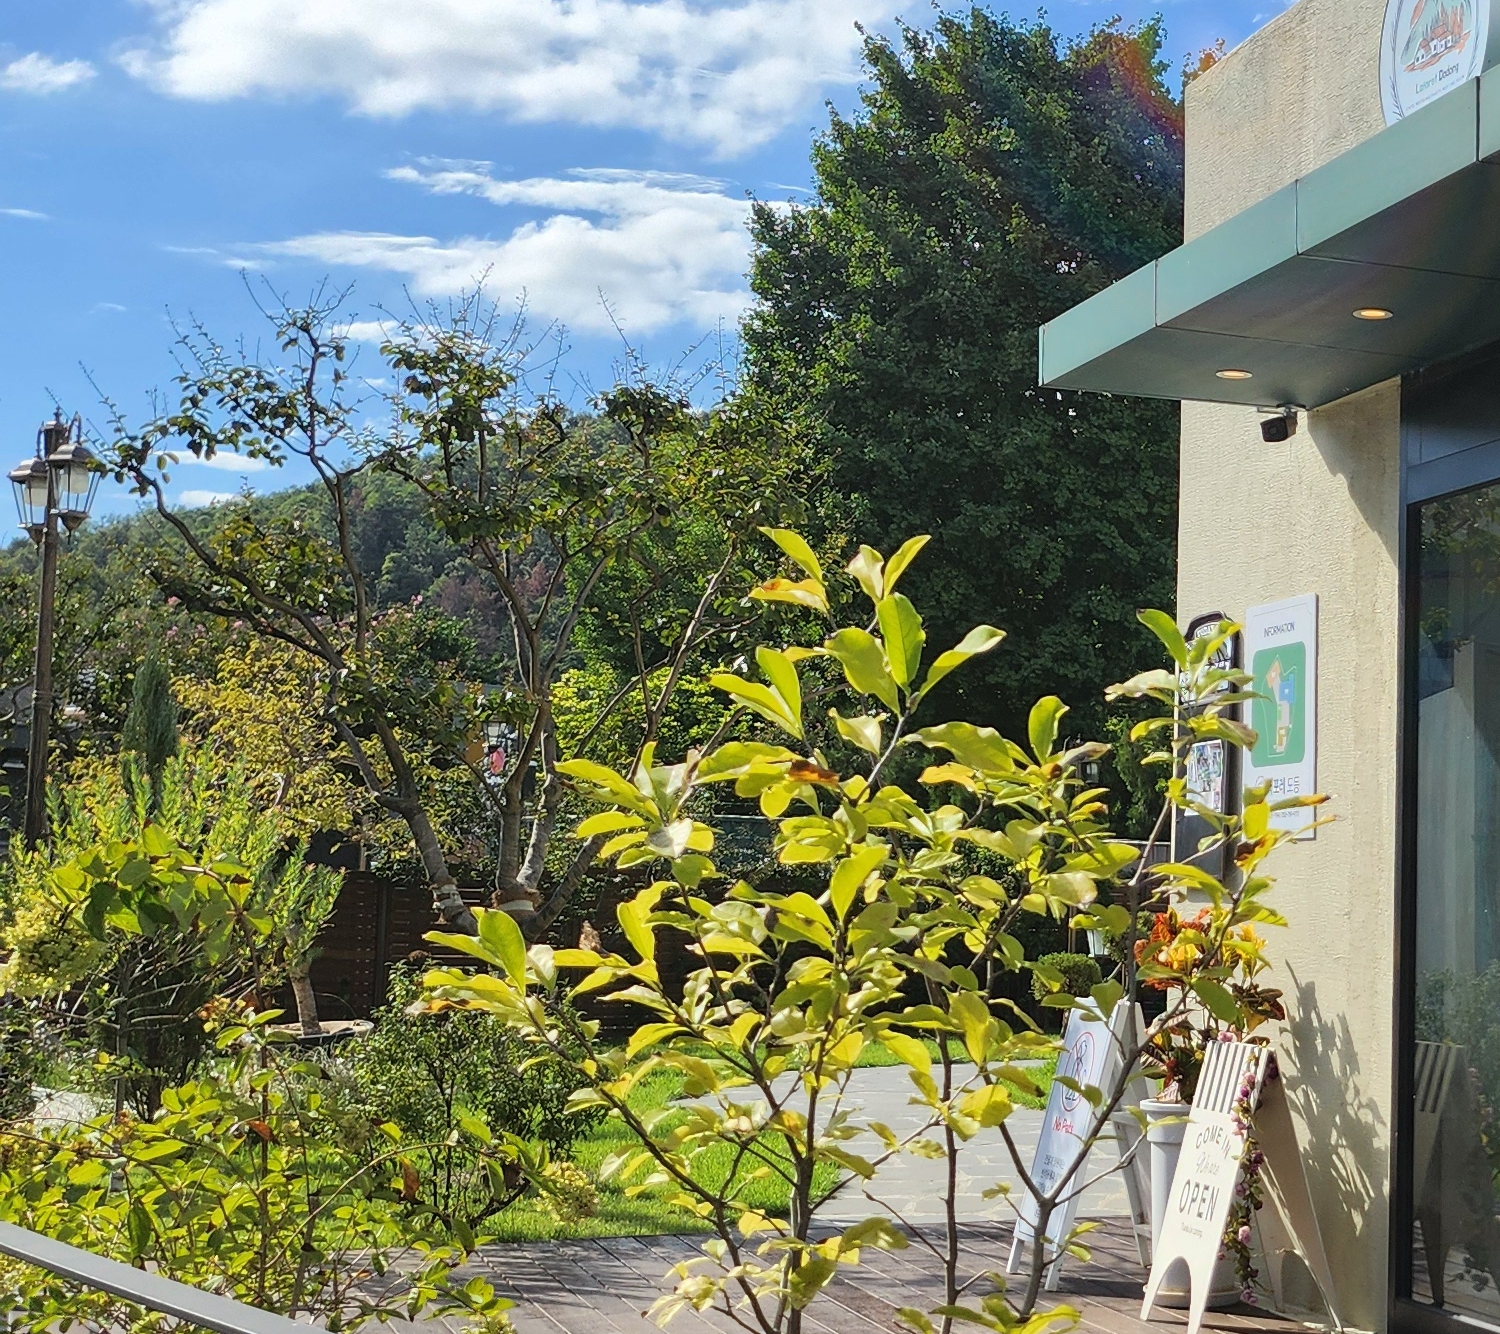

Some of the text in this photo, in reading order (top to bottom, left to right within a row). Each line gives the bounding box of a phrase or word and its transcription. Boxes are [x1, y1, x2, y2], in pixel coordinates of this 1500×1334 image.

[1263, 622, 1295, 637] INFORMATION
[1053, 1116, 1062, 1132] No
[1195, 1125, 1231, 1159] COME IN
[1179, 1179, 1220, 1222] OPEN
